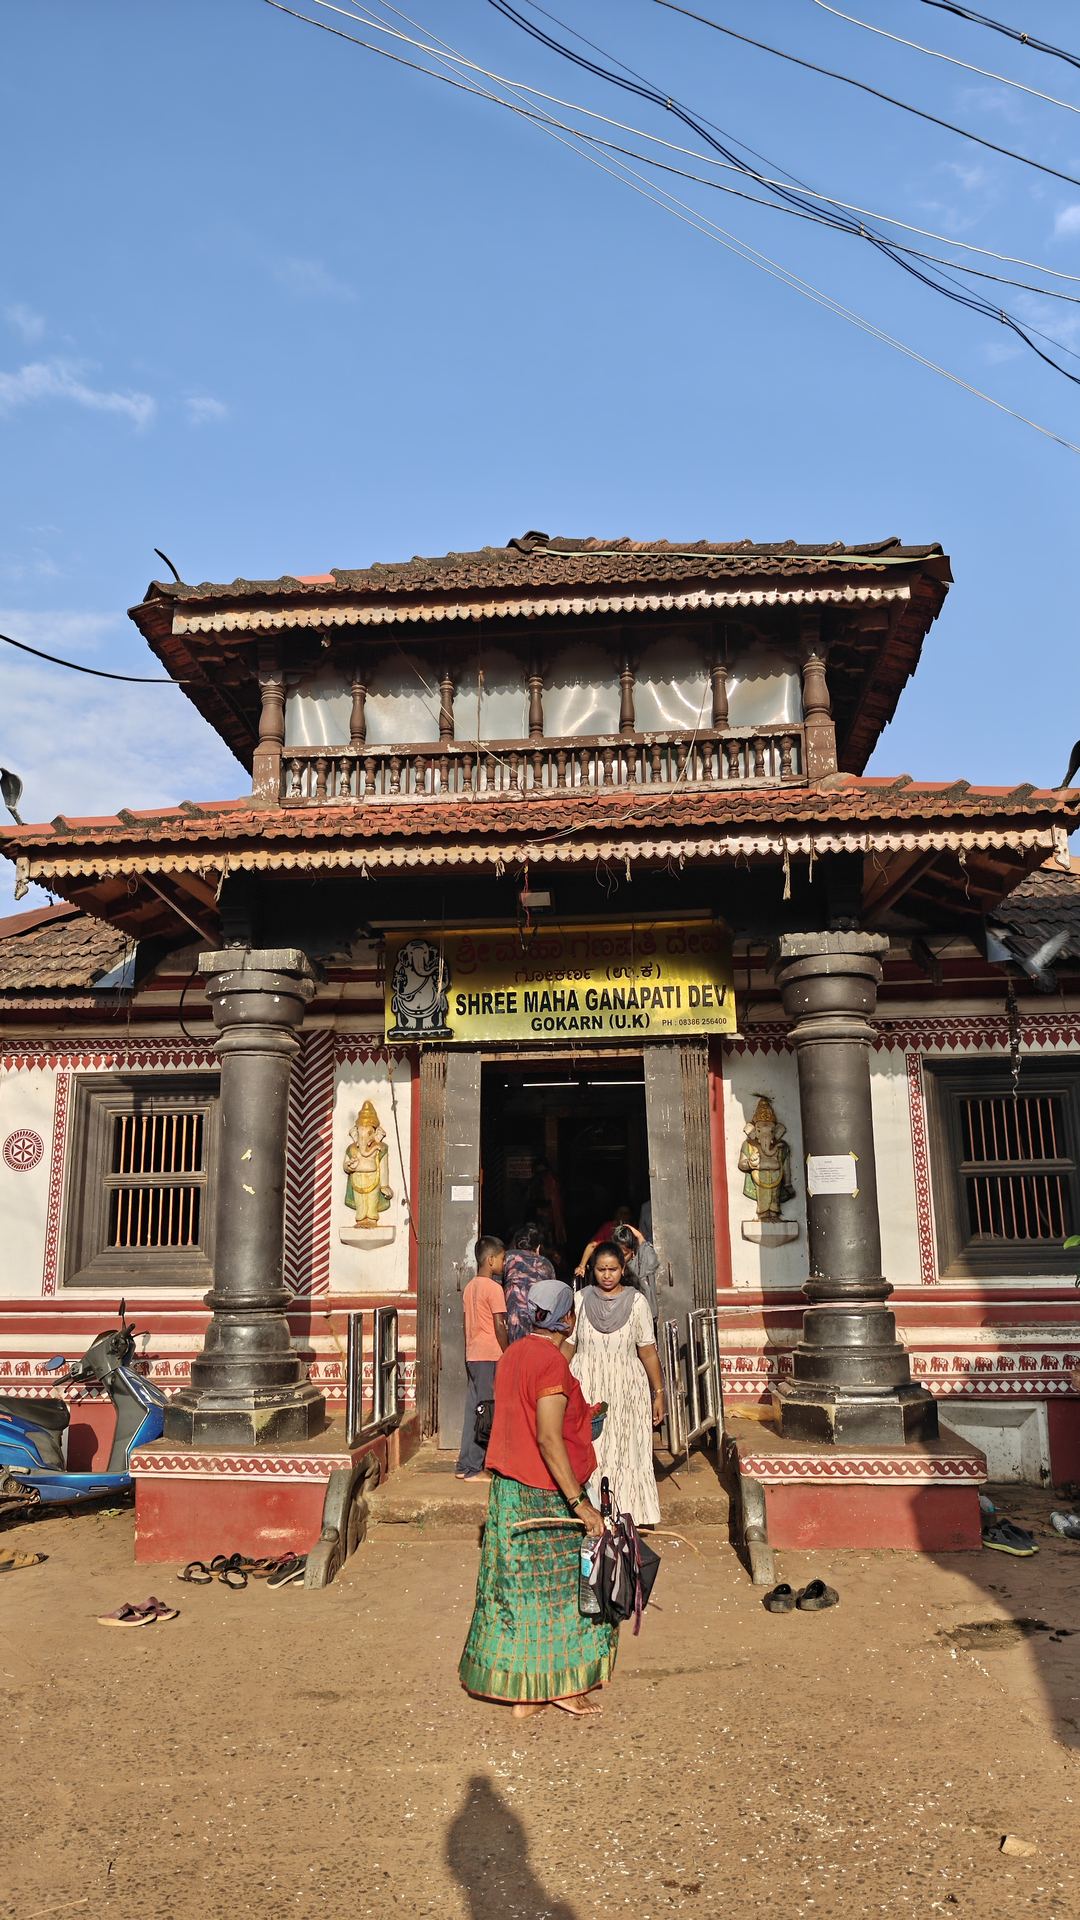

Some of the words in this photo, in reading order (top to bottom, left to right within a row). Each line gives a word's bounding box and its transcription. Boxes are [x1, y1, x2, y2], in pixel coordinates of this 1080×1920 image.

[456, 936, 490, 974] ಶ್ರೀ
[496, 935, 563, 961] ಮಹಾ
[572, 930, 657, 959] ಗಣಪತಿ
[514, 966, 595, 983] ಗೋಕರ್ಣ
[455, 992, 517, 1015] SHREE
[524, 989, 580, 1013] MAHA
[585, 985, 681, 1011] GANAPATI
[688, 984, 727, 1008] DEV
[531, 1015, 603, 1031] GOKARN
[609, 1013, 650, 1030] (U.K)
[678, 1018, 700, 1026] 08386
[701, 1017, 727, 1025] 256400
